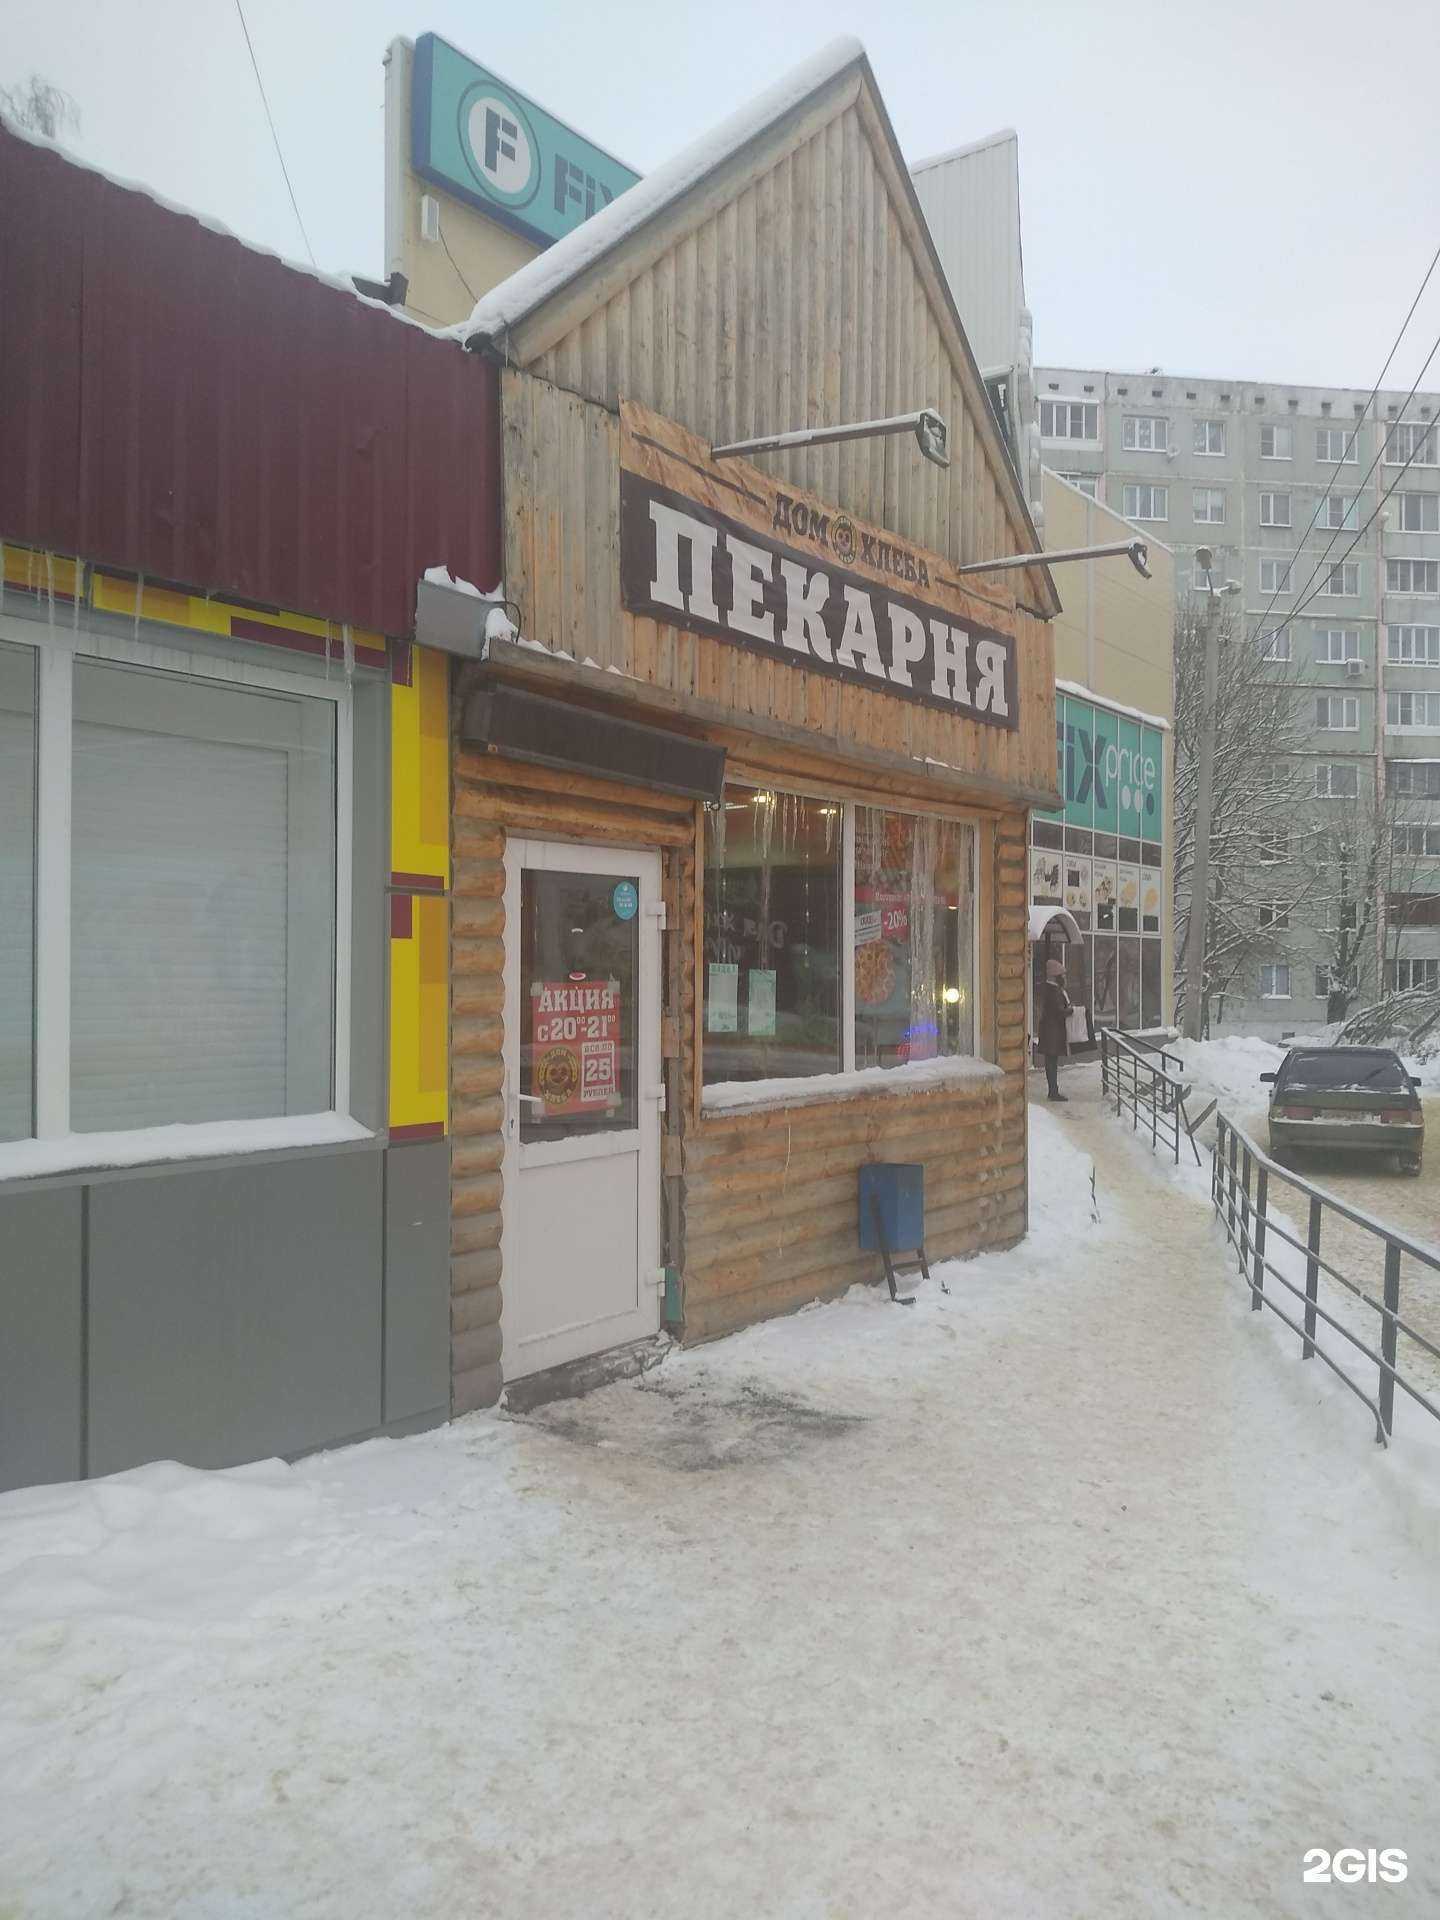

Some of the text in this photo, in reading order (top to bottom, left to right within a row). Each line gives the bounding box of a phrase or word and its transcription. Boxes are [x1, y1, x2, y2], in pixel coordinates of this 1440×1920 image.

[772, 491, 830, 547] ДОМ
[860, 532, 930, 589] ХЛЕБА
[648, 499, 1009, 717] ПЕКАРНЯ
[1105, 744, 1156, 791] price
[538, 988, 616, 1013] АКЦИЯ
[586, 1058, 611, 1082] 25
